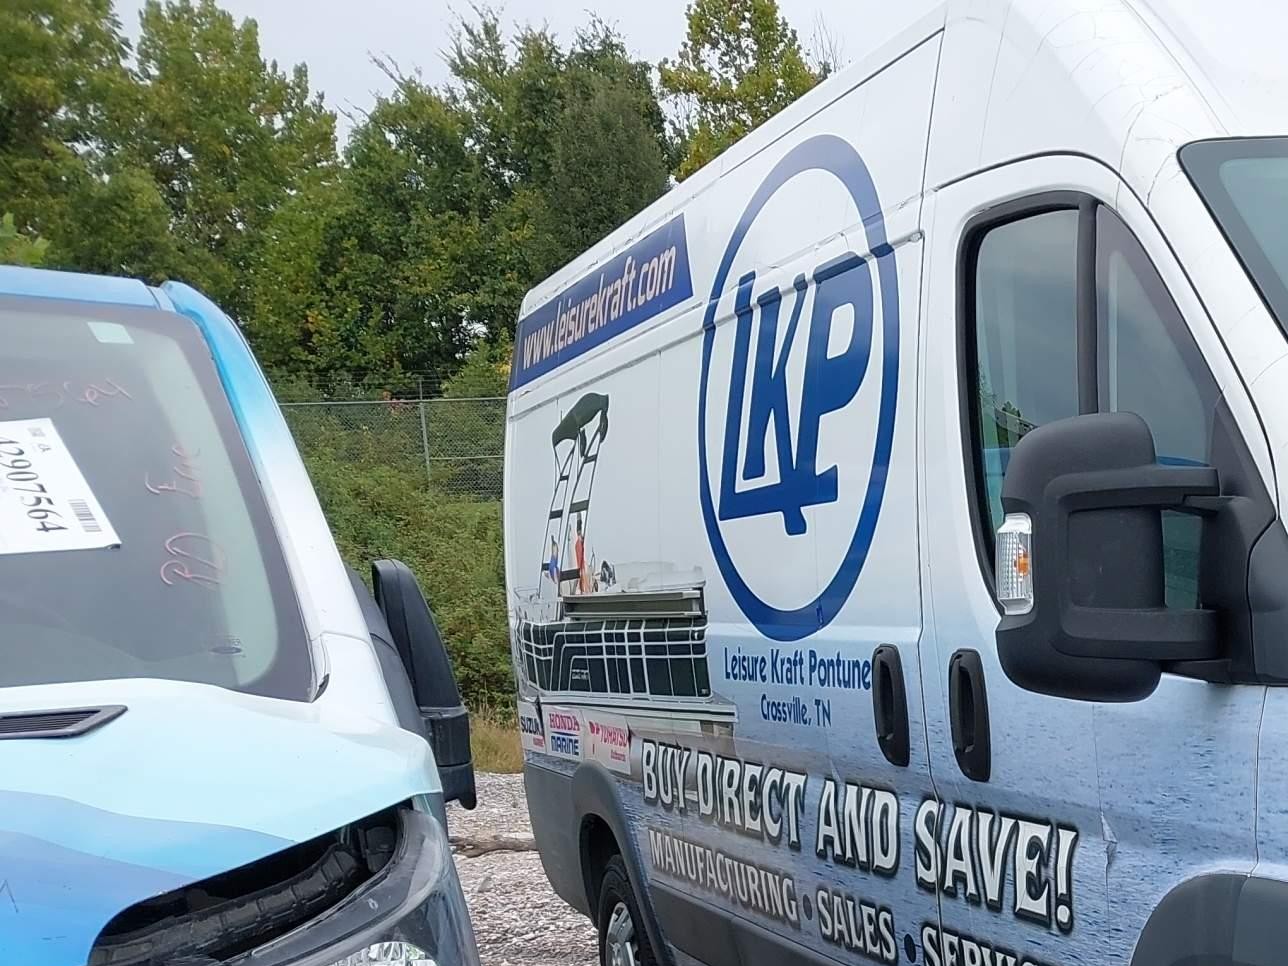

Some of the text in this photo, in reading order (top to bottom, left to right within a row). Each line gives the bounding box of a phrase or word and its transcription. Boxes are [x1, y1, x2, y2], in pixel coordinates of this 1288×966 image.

[523, 246, 677, 371] www.leisurekraft.com
[724, 646, 767, 683] Leisure
[770, 648, 805, 686] Kraft
[548, 713, 580, 732] HONDA
[760, 693, 832, 729] Crossville, TN
[550, 735, 580, 756] MARINE
[642, 740, 1078, 929] BUY DIRECT AND SAVE!
[648, 829, 800, 922] MANUFACTURING
[816, 889, 898, 964] SALES
